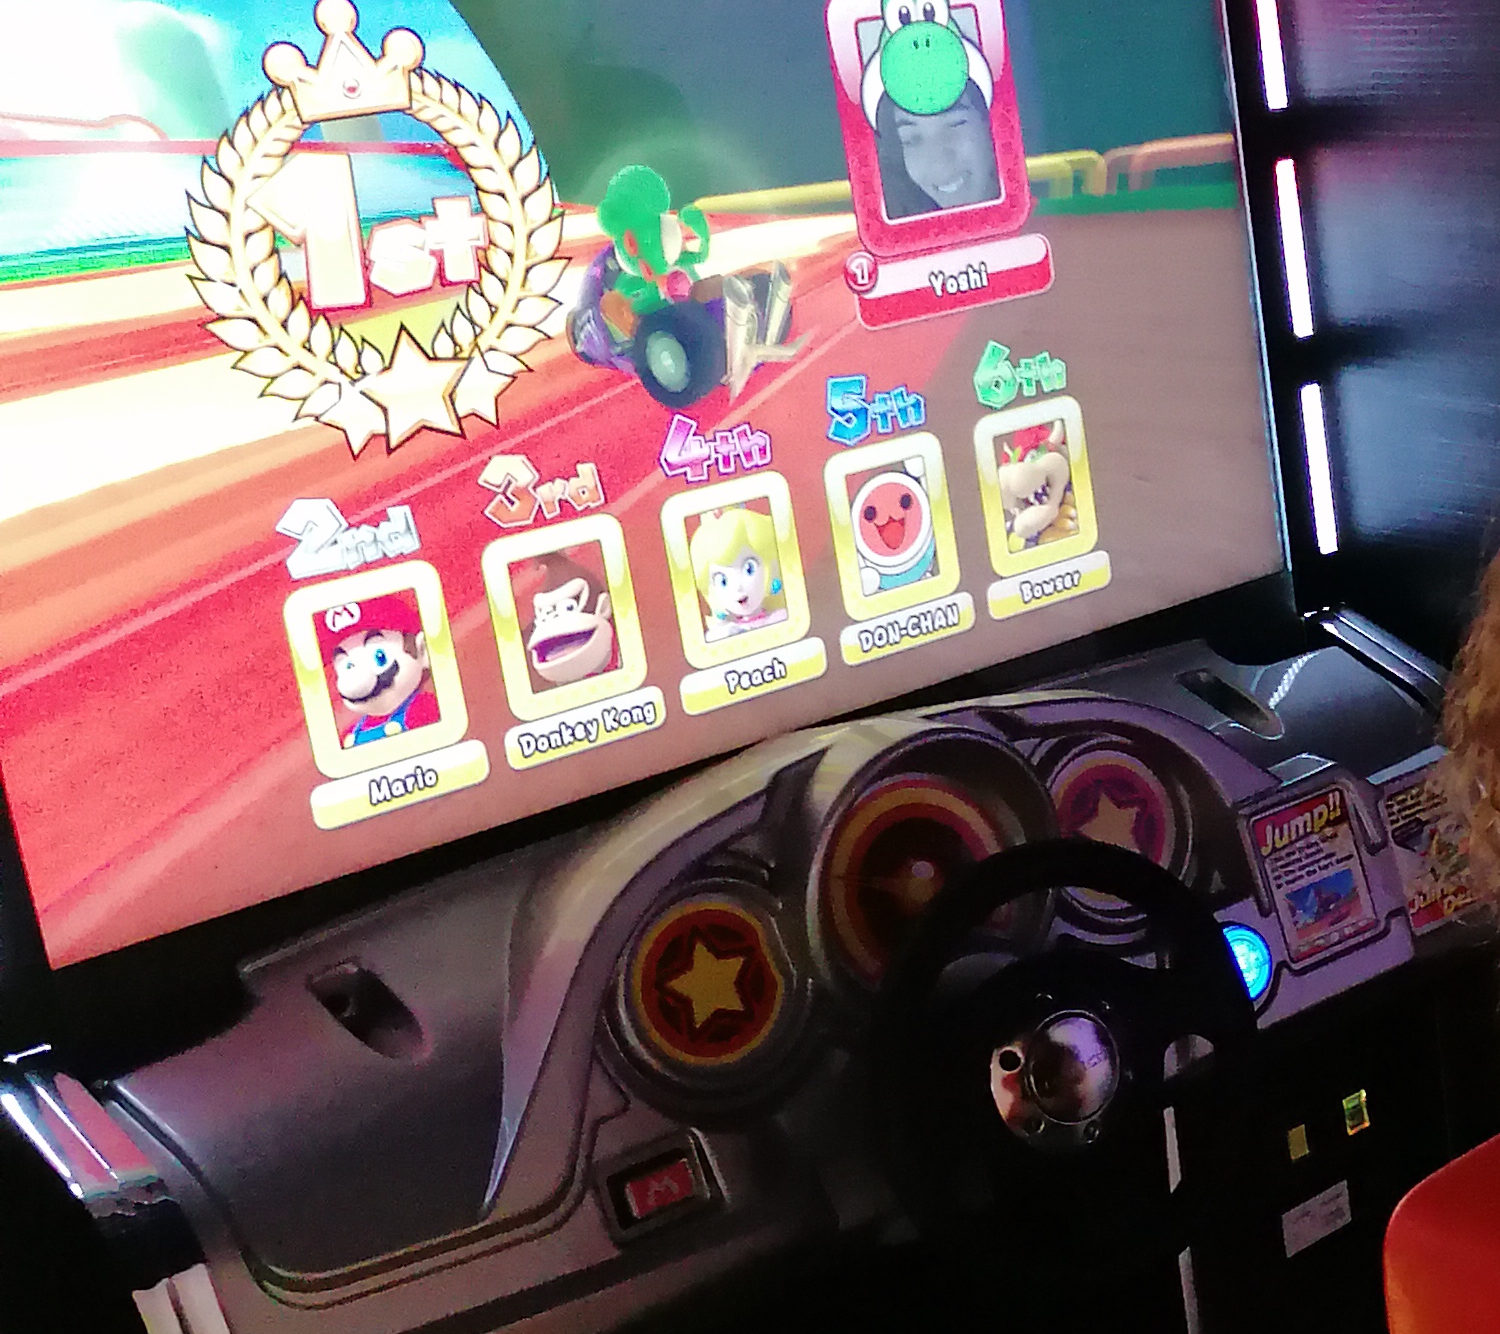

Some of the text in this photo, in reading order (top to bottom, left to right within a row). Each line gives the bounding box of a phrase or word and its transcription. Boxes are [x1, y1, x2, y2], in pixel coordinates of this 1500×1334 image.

[244, 151, 491, 313] 1st
[928, 261, 990, 298] Yoshi
[972, 339, 1068, 410] 6th
[825, 373, 927, 447] 5th
[658, 412, 773, 485] 4th
[476, 453, 606, 529] 3rd
[275, 497, 422, 581] 2nd
[1019, 570, 1083, 604] Bowser
[858, 602, 961, 653] DON-CHAN
[724, 657, 787, 695] Peach
[517, 700, 658, 759] Donkey Kong
[368, 765, 439, 805] Mario
[1260, 790, 1342, 857] Jump!!
